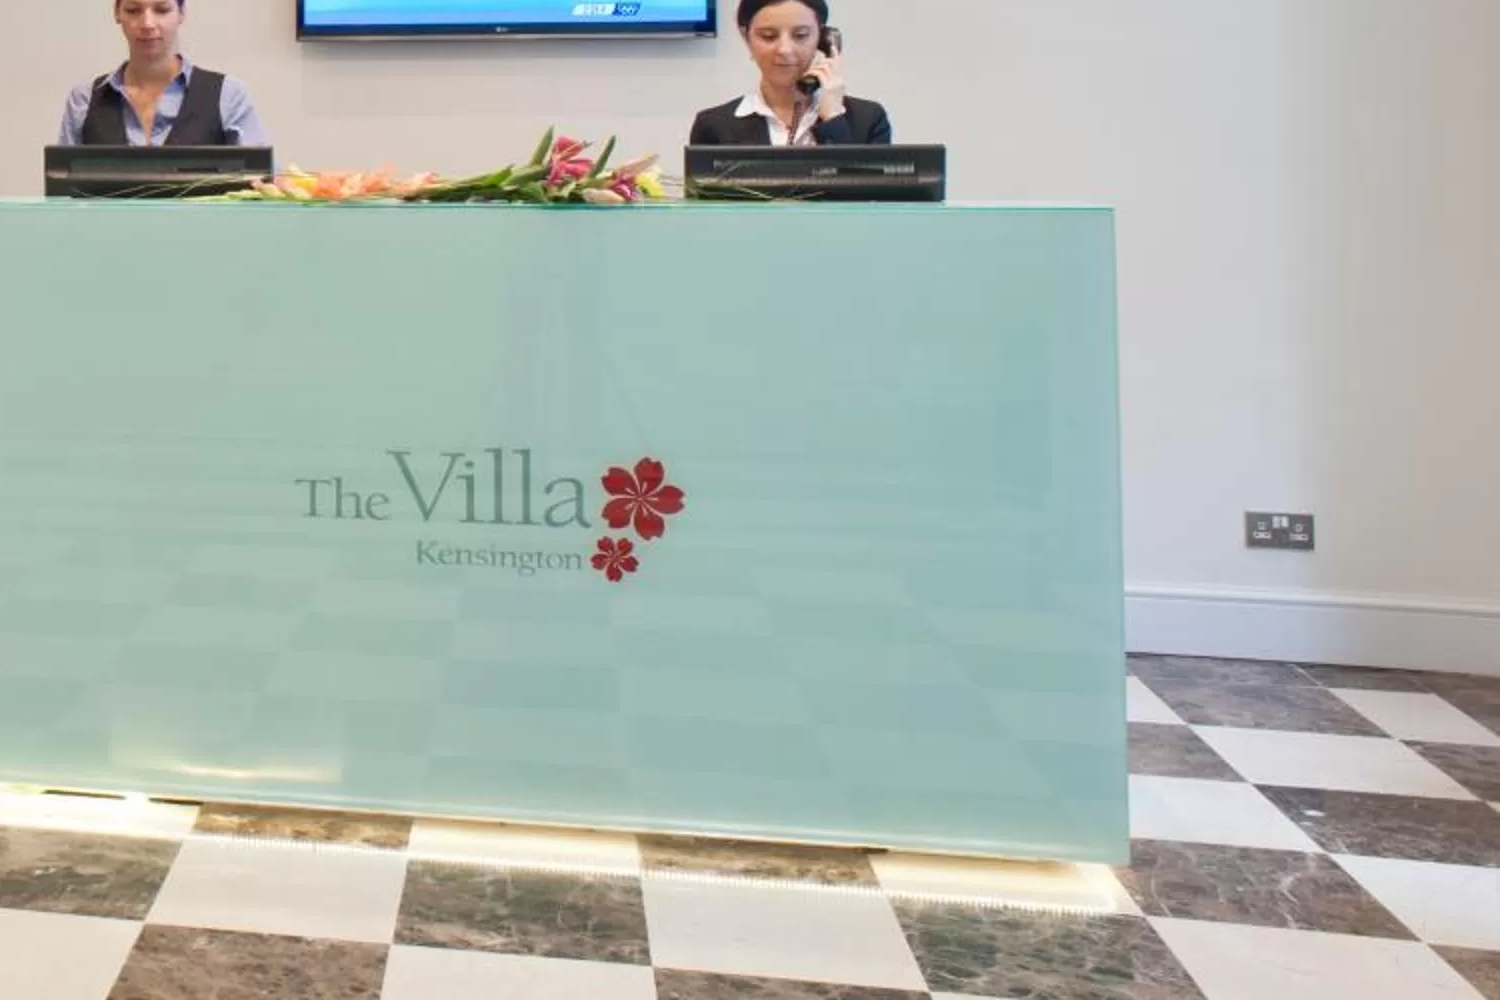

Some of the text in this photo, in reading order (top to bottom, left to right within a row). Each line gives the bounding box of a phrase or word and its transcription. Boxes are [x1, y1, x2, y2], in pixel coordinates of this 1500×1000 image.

[295, 448, 591, 529] The Villa
[417, 540, 581, 575] Kensington
